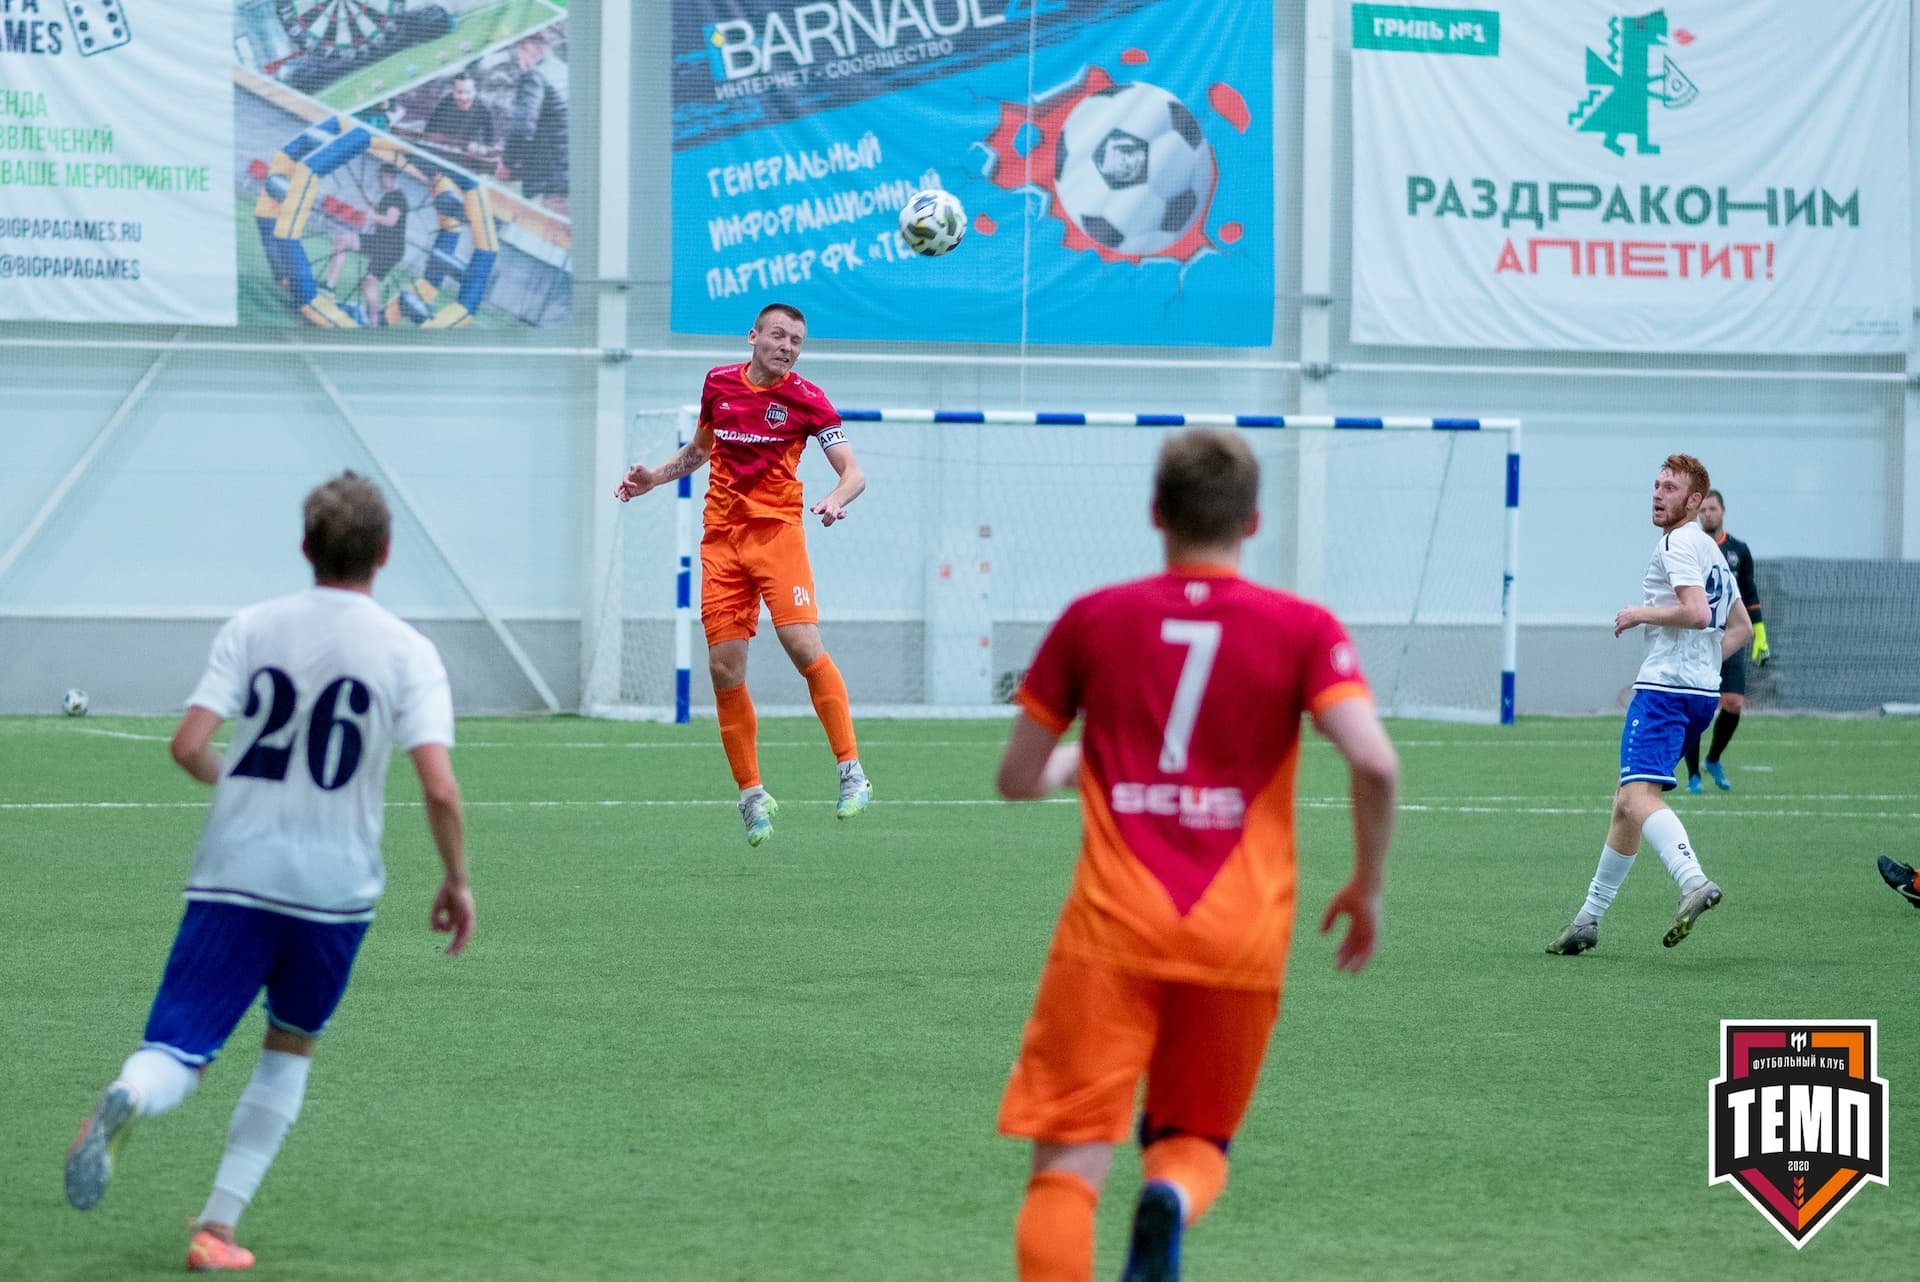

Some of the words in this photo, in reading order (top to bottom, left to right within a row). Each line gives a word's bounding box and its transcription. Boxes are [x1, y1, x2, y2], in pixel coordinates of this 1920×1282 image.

[0, 19, 63, 55] MES
[1449, 22, 1486, 43] №1
[715, 67, 810, 100] ИНТЕРНЕТ
[826, 39, 952, 80] СООБЩЕСТВО
[65, 162, 210, 192] МЕРОПРИЯТИЕ
[707, 130, 883, 199] ГЕНЕРАЛЬНЫЙ
[1407, 175, 1860, 231] РАЗДРАКОНИМ
[706, 250, 817, 300] ПАРТНЕР
[821, 239, 864, 274] ФК
[1494, 236, 1775, 280] АППЕТИТ!
[792, 586, 810, 607] 24
[1159, 618, 1223, 773] 7
[228, 666, 372, 791] 26
